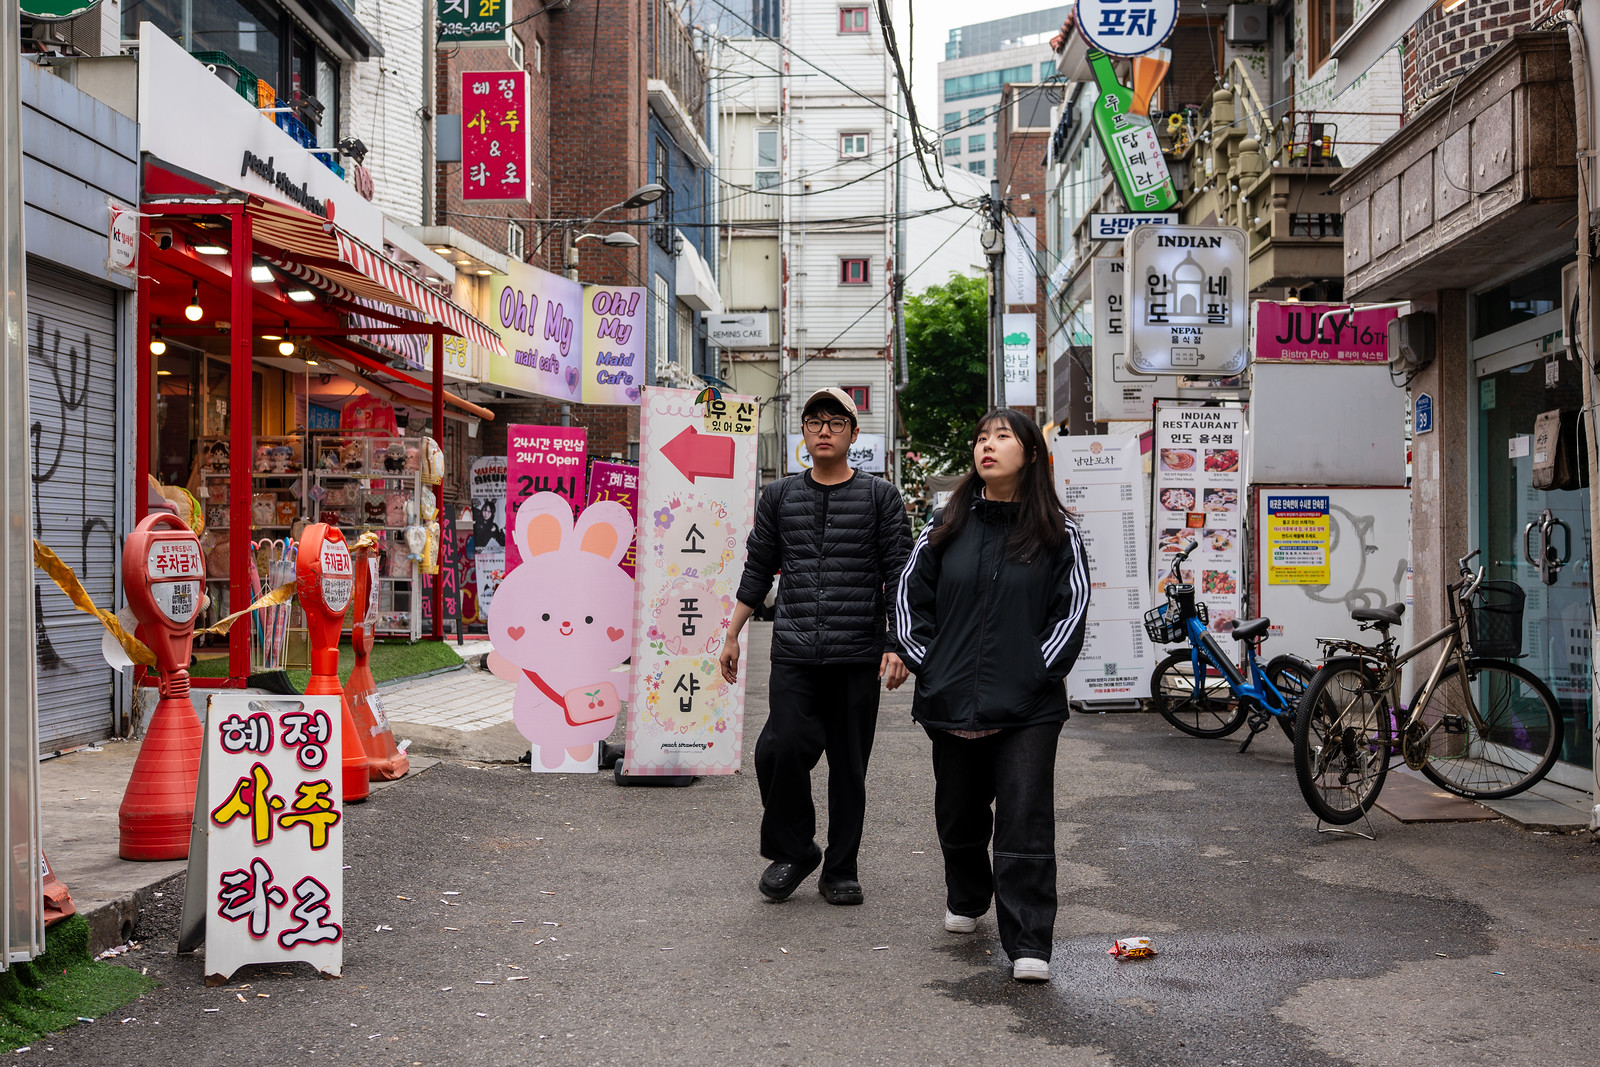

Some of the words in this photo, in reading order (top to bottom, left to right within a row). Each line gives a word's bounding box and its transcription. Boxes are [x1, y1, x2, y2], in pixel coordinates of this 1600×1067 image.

[479, 0, 500, 16] 2F
[1098, 9, 1157, 36] 포차
[472, 78, 517, 99] 혜정
[467, 108, 522, 136] 사주
[489, 141, 502, 158] &
[241, 150, 275, 184] peach
[468, 162, 522, 188] 타로
[1146, 132, 1172, 198] ROOFTOP
[113, 227, 121, 242] kt
[1158, 236, 1222, 248] INDIAN
[592, 291, 640, 317] Oh!
[1148, 274, 1169, 323] 인도
[1207, 276, 1228, 324] 네팔
[500, 286, 538, 336] Oh!
[544, 300, 574, 357] My
[597, 318, 632, 345] My
[1276, 312, 1348, 345] JULY
[1171, 336, 1202, 344] 음식점
[514, 348, 538, 369] maid
[539, 353, 560, 375] cafe
[596, 352, 635, 367] Maid
[1282, 350, 1308, 358] Bistro
[1310, 350, 1329, 359] Pub
[1362, 351, 1384, 360] 식스틴
[597, 370, 633, 385] Cafe
[711, 402, 754, 422] 우산
[1420, 413, 1427, 428] 39
[712, 420, 744, 433] 있어요
[513, 438, 550, 451] 24시간
[553, 438, 584, 452] 무인샵
[1171, 434, 1192, 443] 인도
[1199, 434, 1232, 444] 음식점
[516, 452, 544, 465] 24/7
[546, 454, 579, 467] Open
[1074, 456, 1115, 466] 낭만포차
[517, 475, 576, 499] 24시
[609, 472, 638, 489] 혜정
[156, 553, 198, 574] 주차금지
[324, 553, 349, 572] 주차금지
[673, 523, 706, 713] 소품샵
[218, 709, 333, 771] 혜정
[660, 741, 677, 749] peach
[678, 742, 707, 750] strawberry
[210, 761, 342, 851] 사주
[217, 856, 343, 950] 타로
